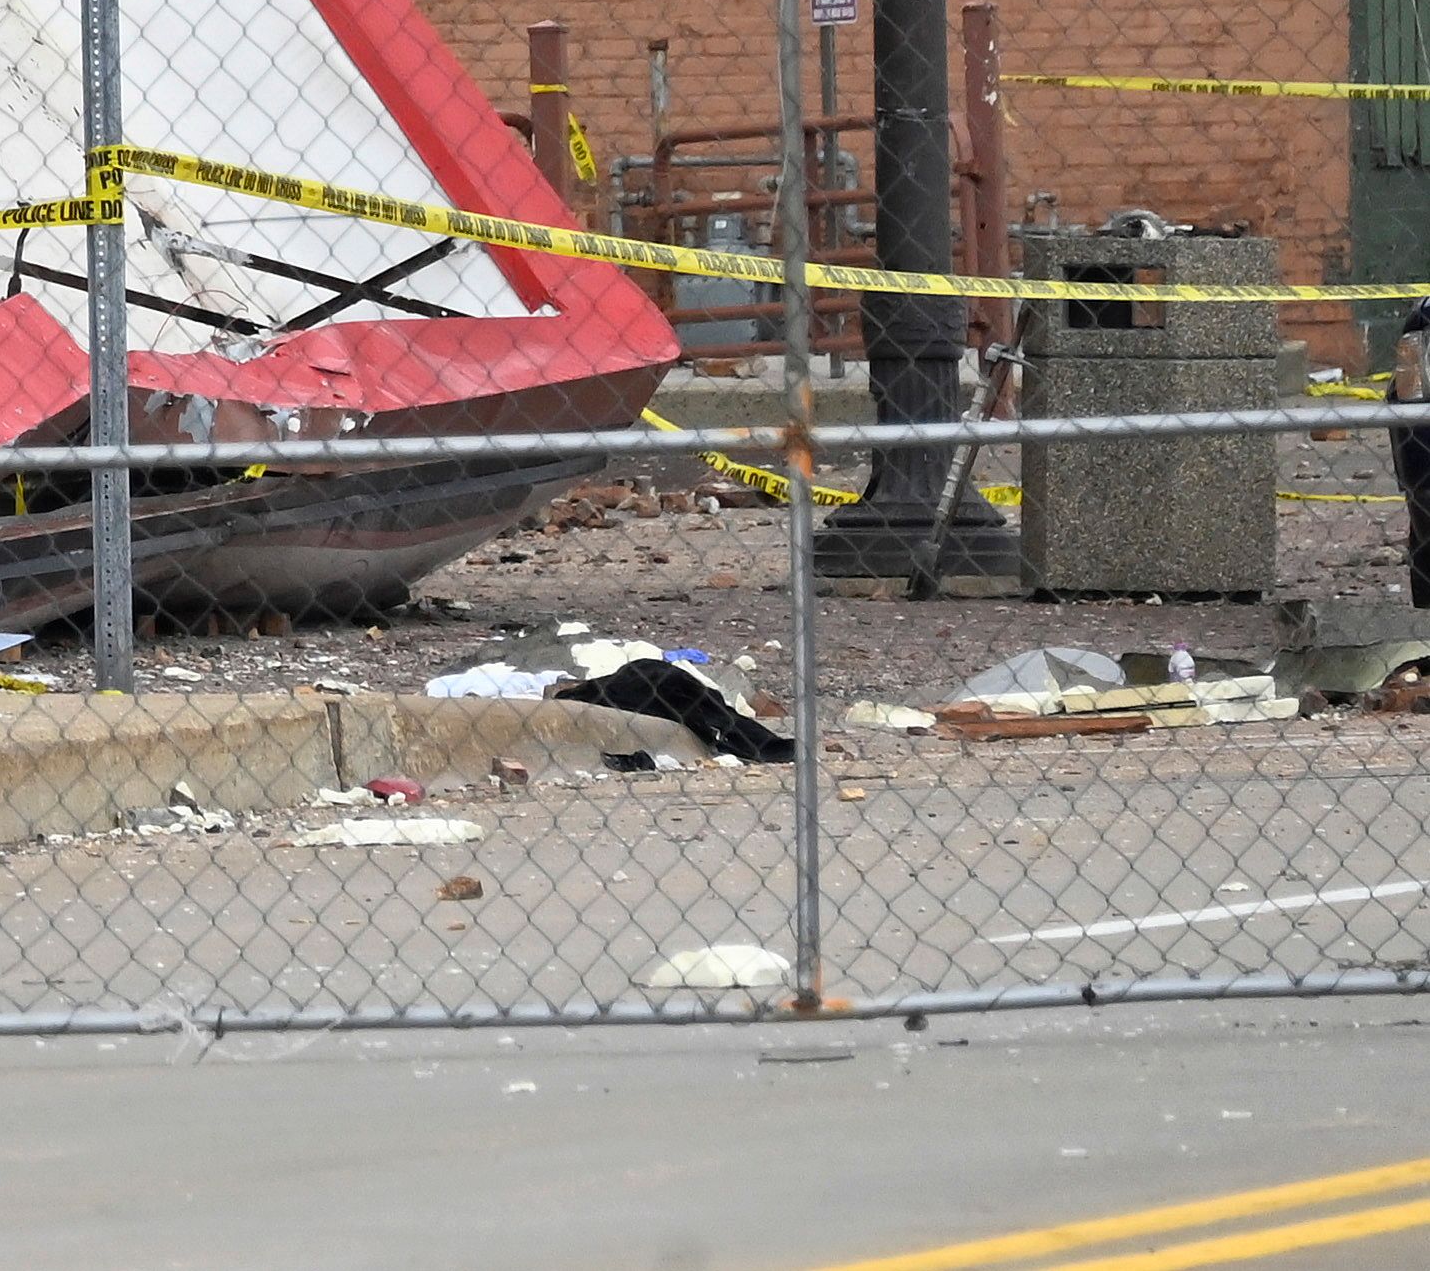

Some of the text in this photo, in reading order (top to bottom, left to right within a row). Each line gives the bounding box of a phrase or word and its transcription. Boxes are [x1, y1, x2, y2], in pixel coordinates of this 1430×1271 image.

[1, 199, 123, 225] POLICE LINE DO
